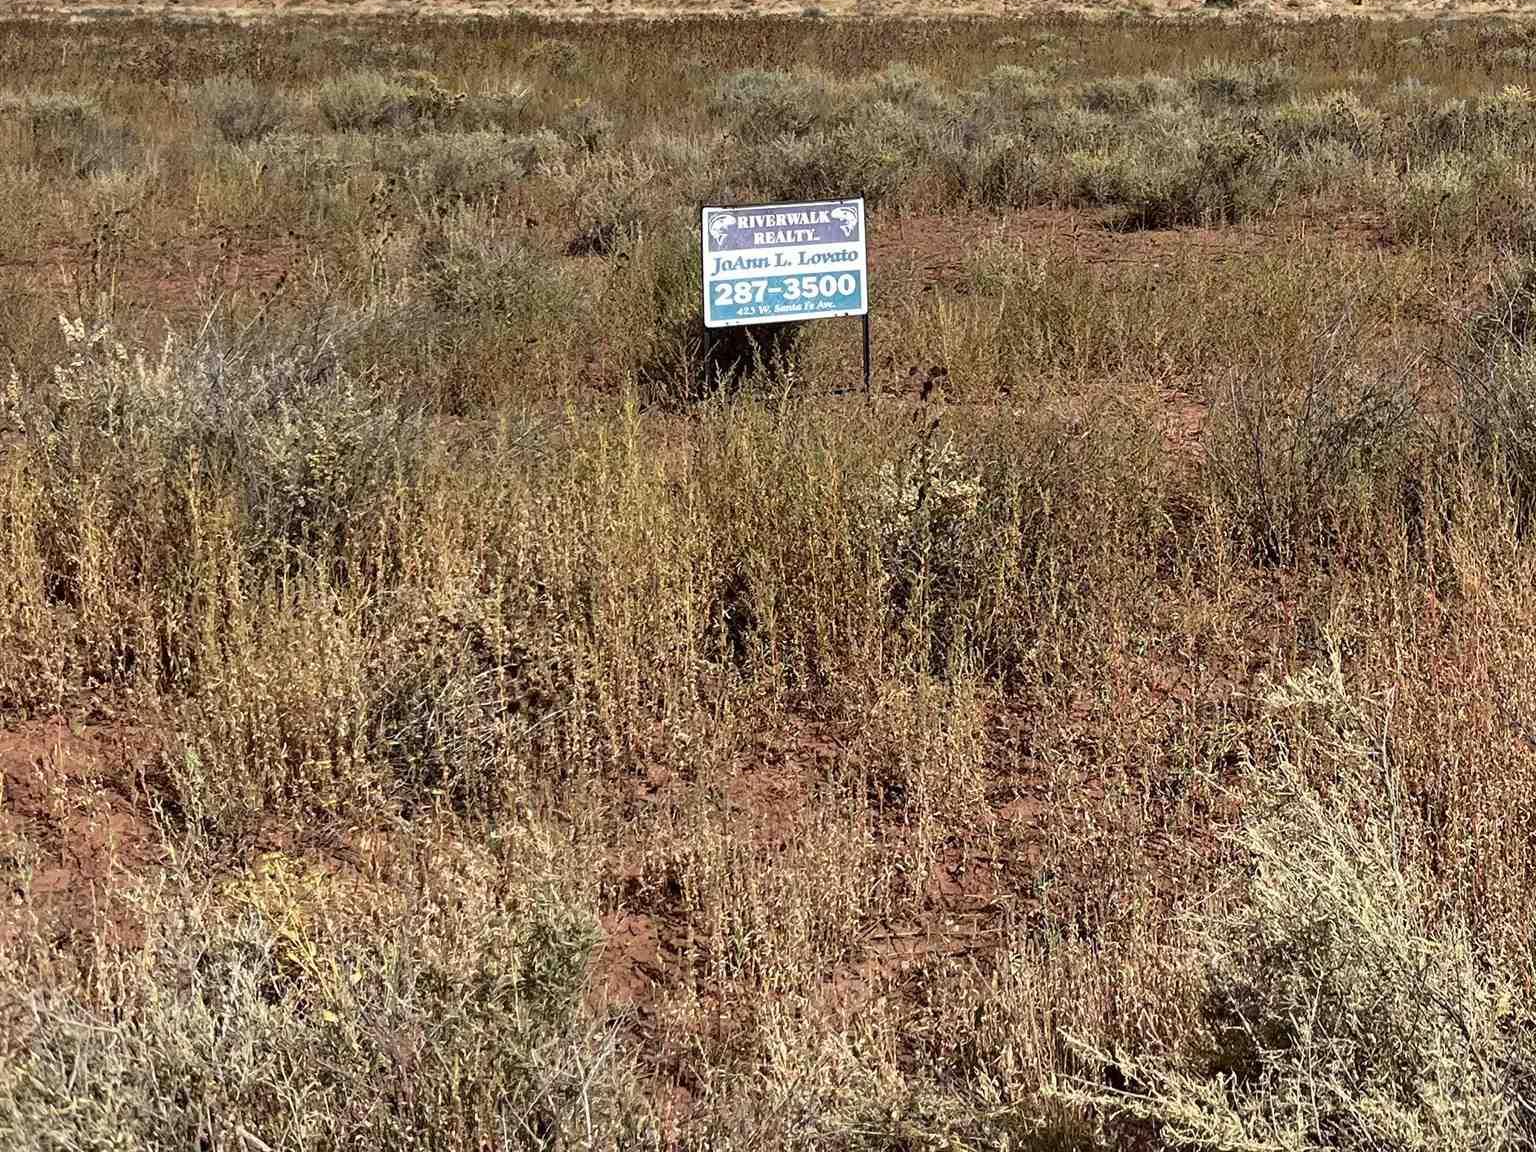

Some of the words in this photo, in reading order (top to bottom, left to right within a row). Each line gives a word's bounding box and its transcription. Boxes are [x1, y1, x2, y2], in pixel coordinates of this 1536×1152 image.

[737, 211, 831, 229] RIVERWALK
[711, 256, 769, 276] JoAnn
[774, 253, 792, 267] L.
[797, 250, 859, 266] Lovato
[714, 274, 856, 306] 287-3500
[774, 303, 801, 313] Santa
